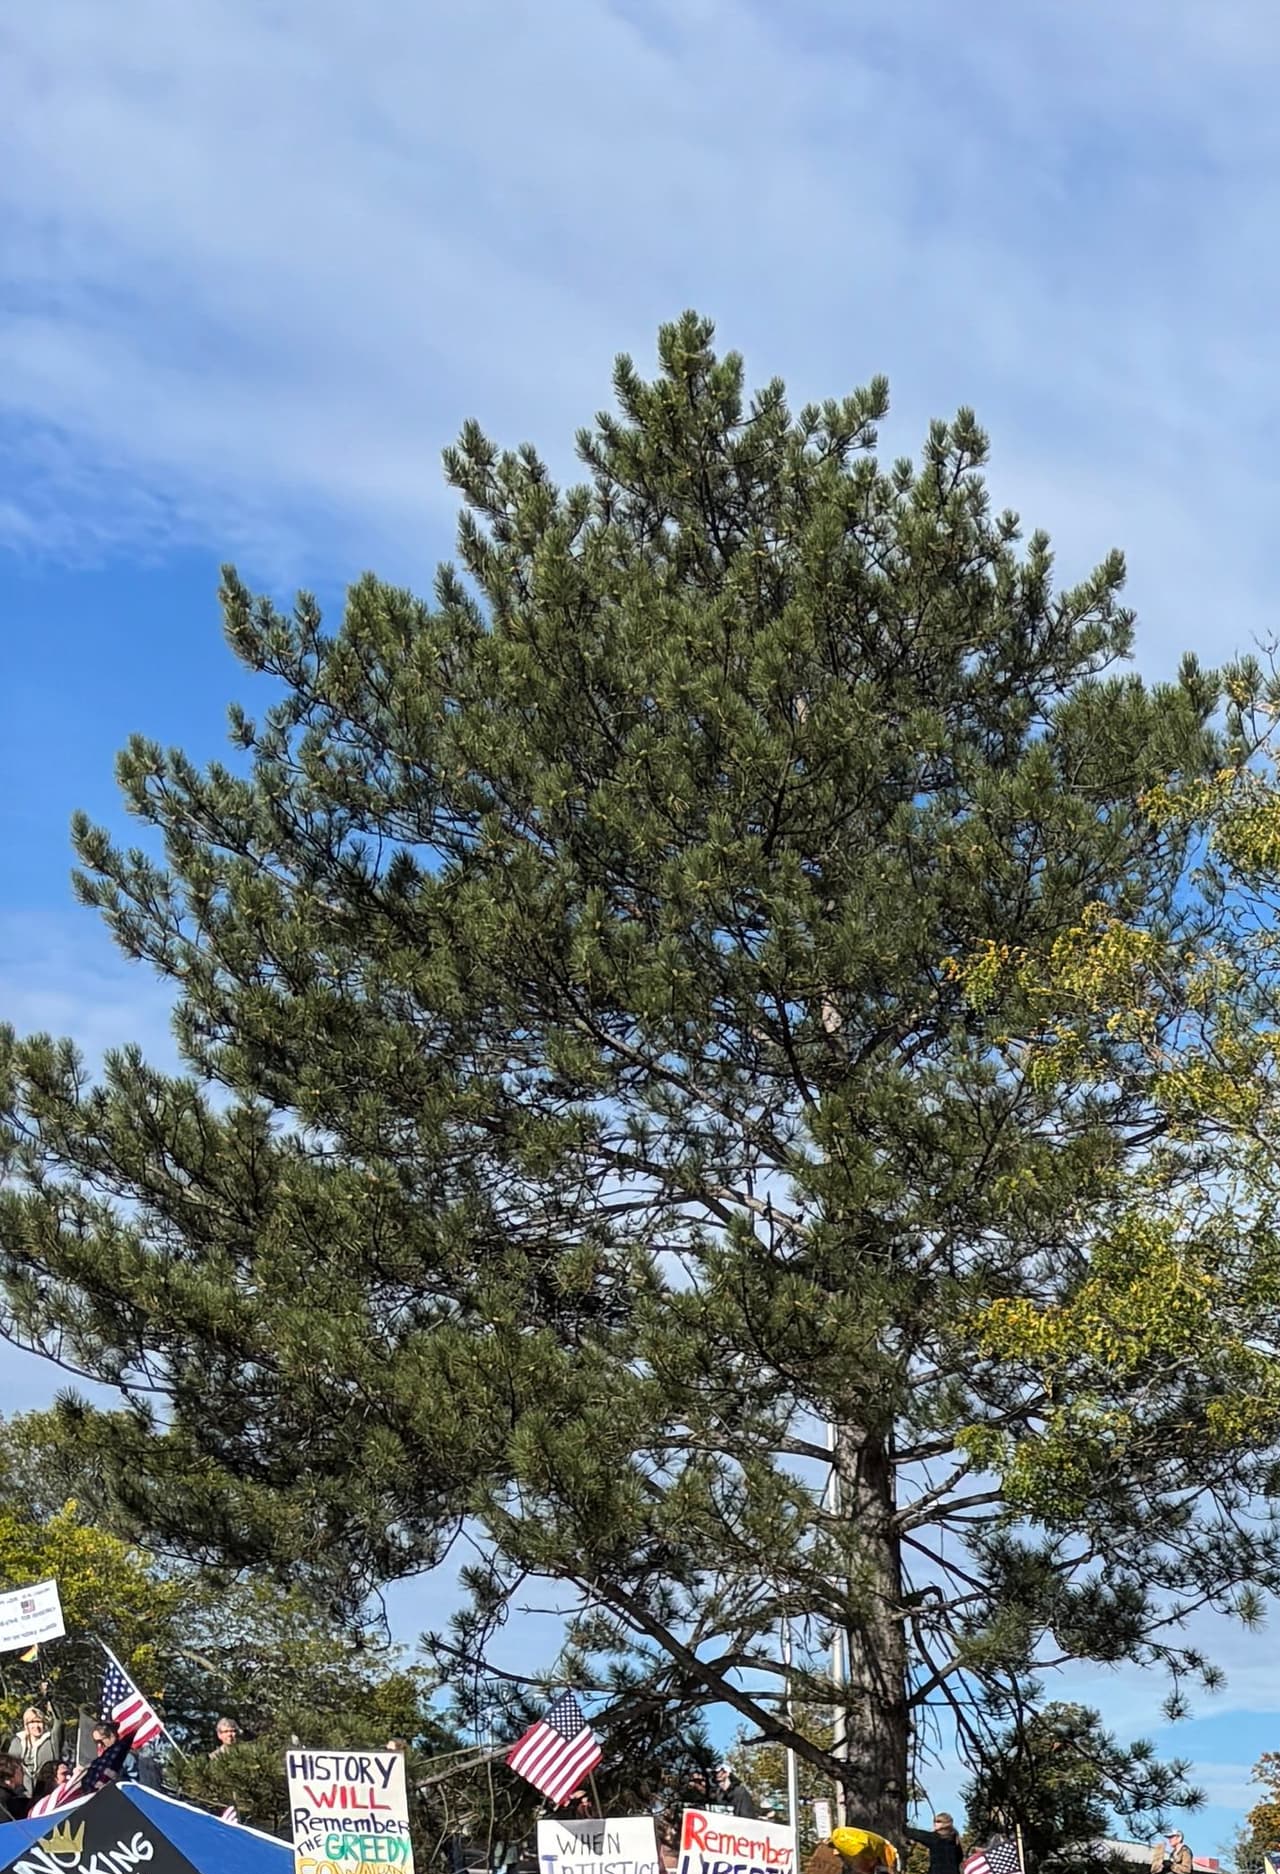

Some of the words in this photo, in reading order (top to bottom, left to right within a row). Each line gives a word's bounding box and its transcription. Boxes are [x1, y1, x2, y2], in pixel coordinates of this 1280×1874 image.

[289, 1755, 397, 1789] HISTORY
[304, 1784, 391, 1810] WILL
[297, 1834, 323, 1856] THE
[325, 1834, 410, 1864] GREEDY
[556, 1833, 621, 1855] WHEN
[684, 1813, 793, 1865] Remember
